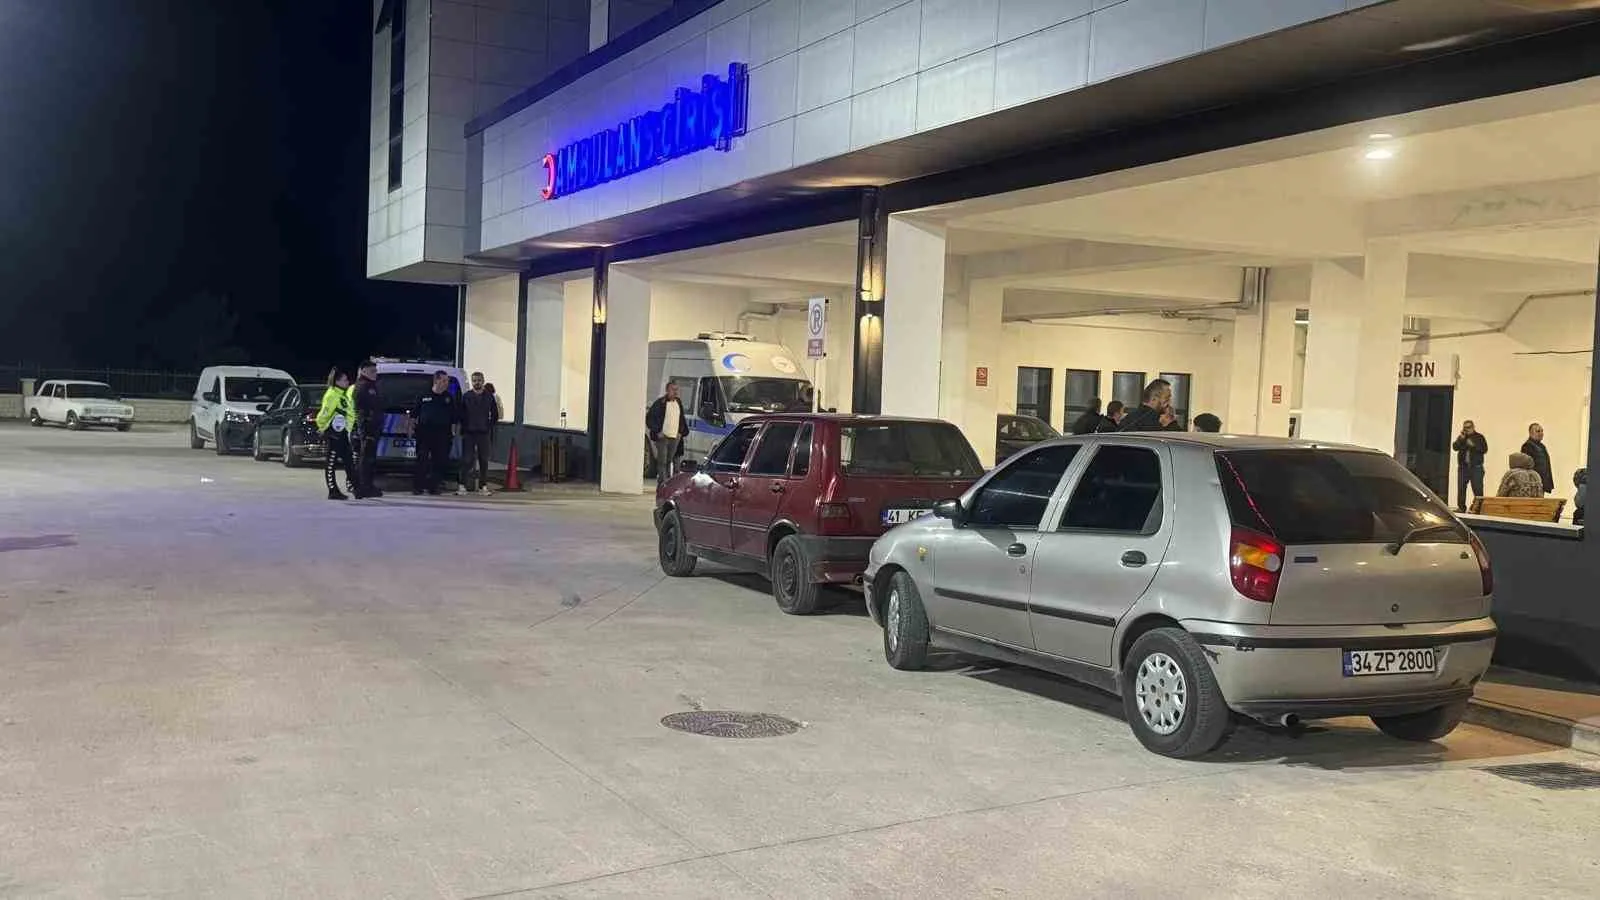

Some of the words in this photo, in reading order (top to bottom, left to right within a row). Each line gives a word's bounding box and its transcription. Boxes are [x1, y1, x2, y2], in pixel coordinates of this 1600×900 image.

[556, 110, 658, 199] AMBULANS
[889, 510, 900, 522] 41
[1352, 652, 1372, 672] 34
[1374, 652, 1396, 671] ZP
[1398, 650, 1433, 670] 2800
